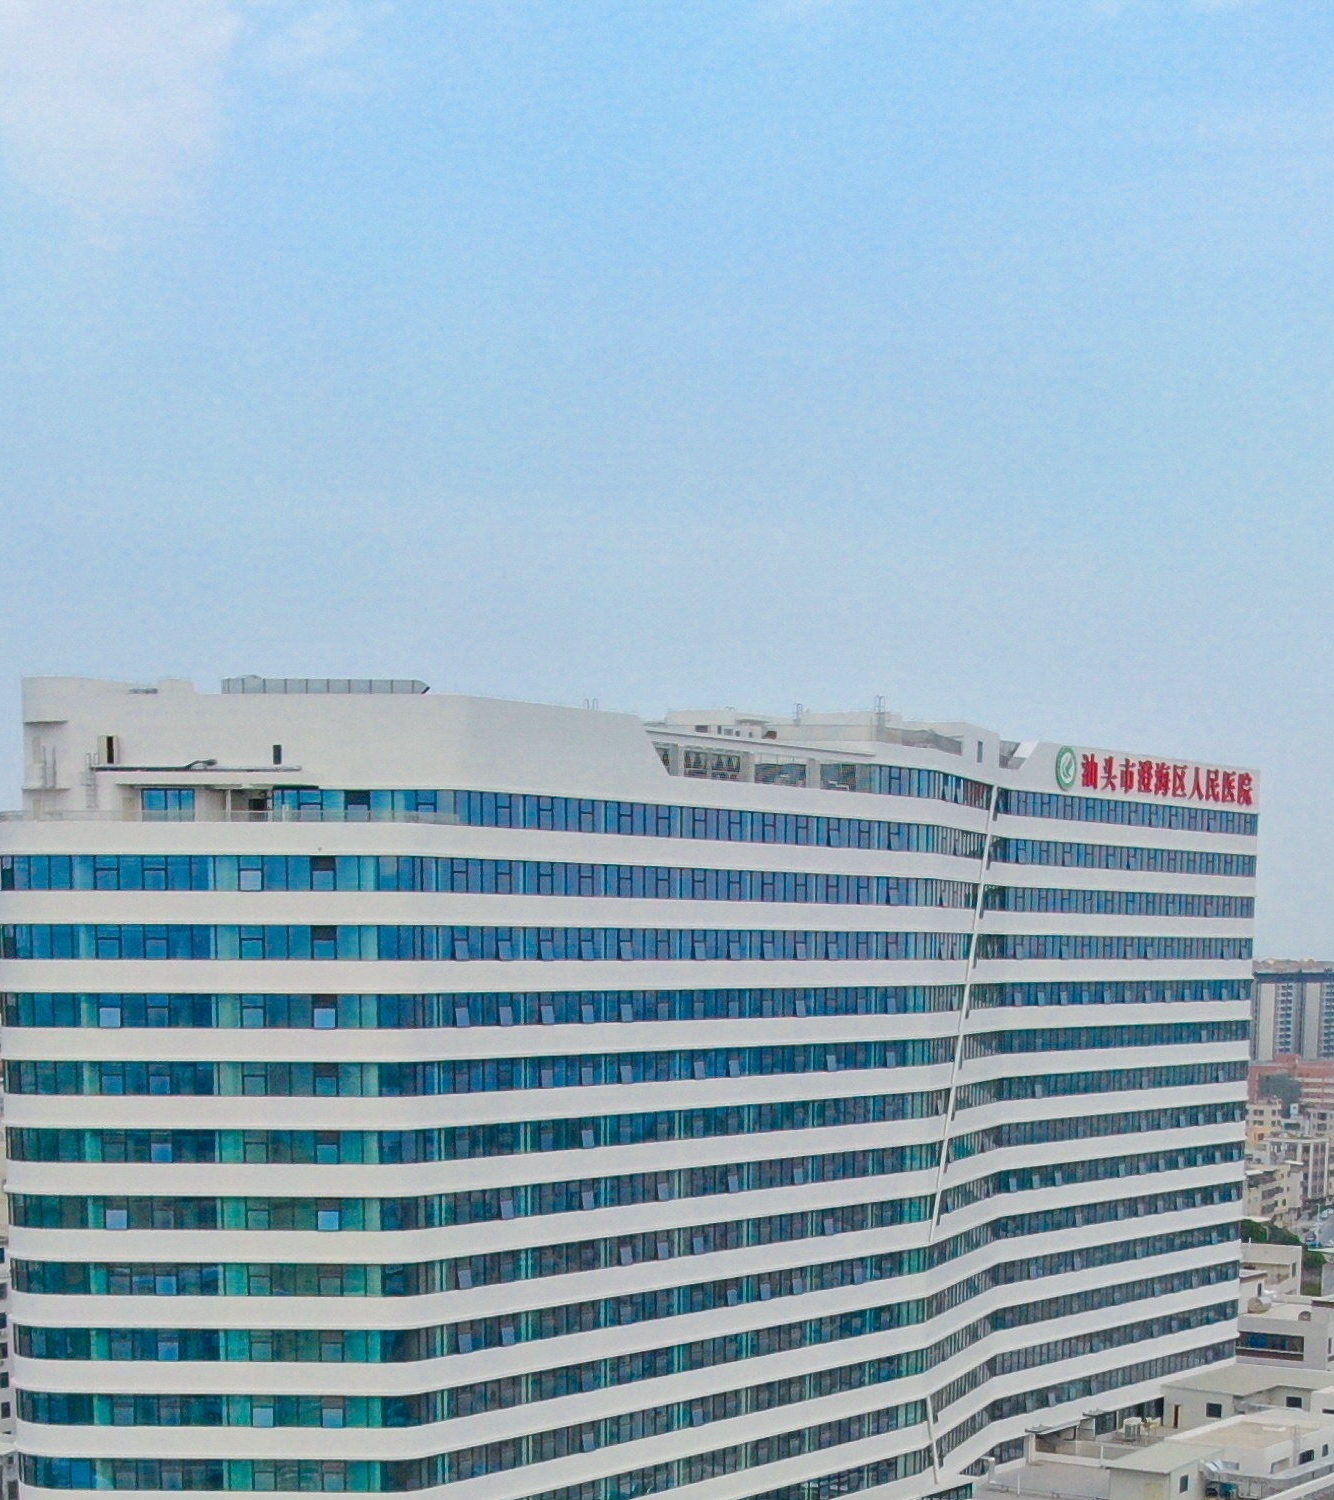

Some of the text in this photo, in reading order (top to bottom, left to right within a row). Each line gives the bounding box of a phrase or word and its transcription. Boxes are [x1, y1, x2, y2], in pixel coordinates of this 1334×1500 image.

[1080, 753, 1253, 806] 汕头市澄海区人民医院
